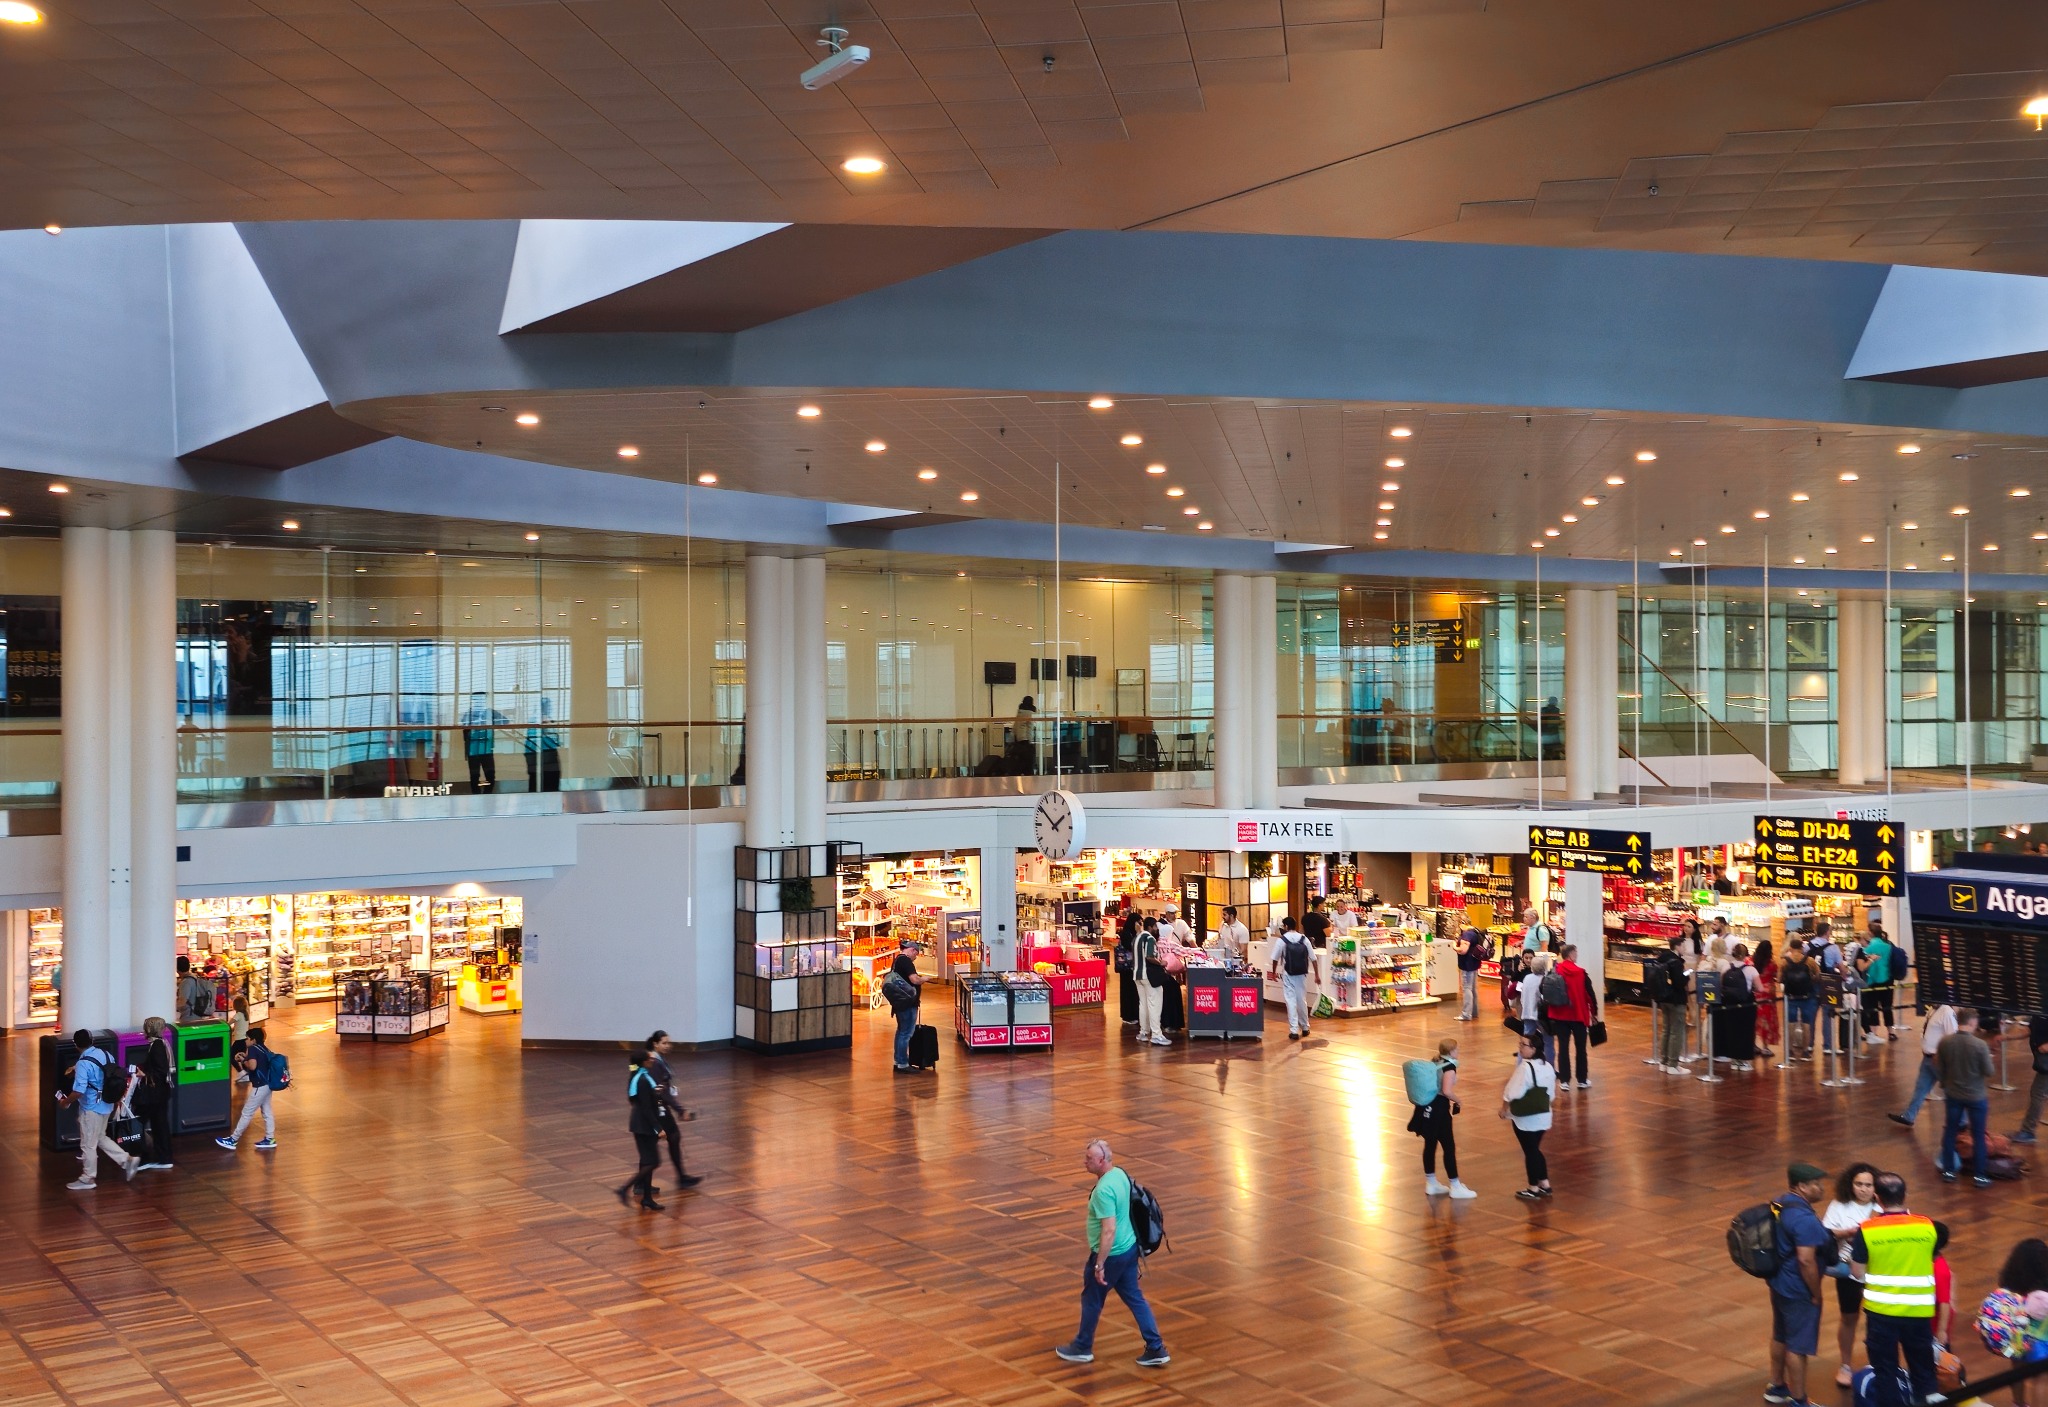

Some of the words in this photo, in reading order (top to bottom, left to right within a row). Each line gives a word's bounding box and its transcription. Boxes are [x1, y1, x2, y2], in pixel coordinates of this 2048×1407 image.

[1775, 819, 1795, 828] Gate
[1260, 822, 1290, 837] TAX
[1294, 822, 1334, 837] FREE
[1546, 828, 1565, 837] Gates
[1776, 828, 1799, 838] Gates
[1803, 821, 1851, 841] D1-D4
[1546, 837, 1565, 846] Gates
[1775, 843, 1795, 852] Gate
[1561, 851, 1587, 862] Udgang
[1776, 854, 1799, 862] Gates
[1803, 846, 1858, 866] E1-E24
[1561, 859, 1575, 868] Exit
[1775, 867, 1795, 876] Gate
[1776, 877, 1799, 886] Gates
[1803, 869, 1858, 891] F6-F10
[1986, 886, 2048, 920] Afga
[1065, 979, 1086, 992] MAKE
[1087, 977, 1101, 989] JOY
[1071, 990, 1101, 1004] HAPPEN
[974, 1029, 987, 1037] GOOD
[974, 1035, 988, 1043] VALUE
[1016, 1034, 1030, 1042] VALUE
